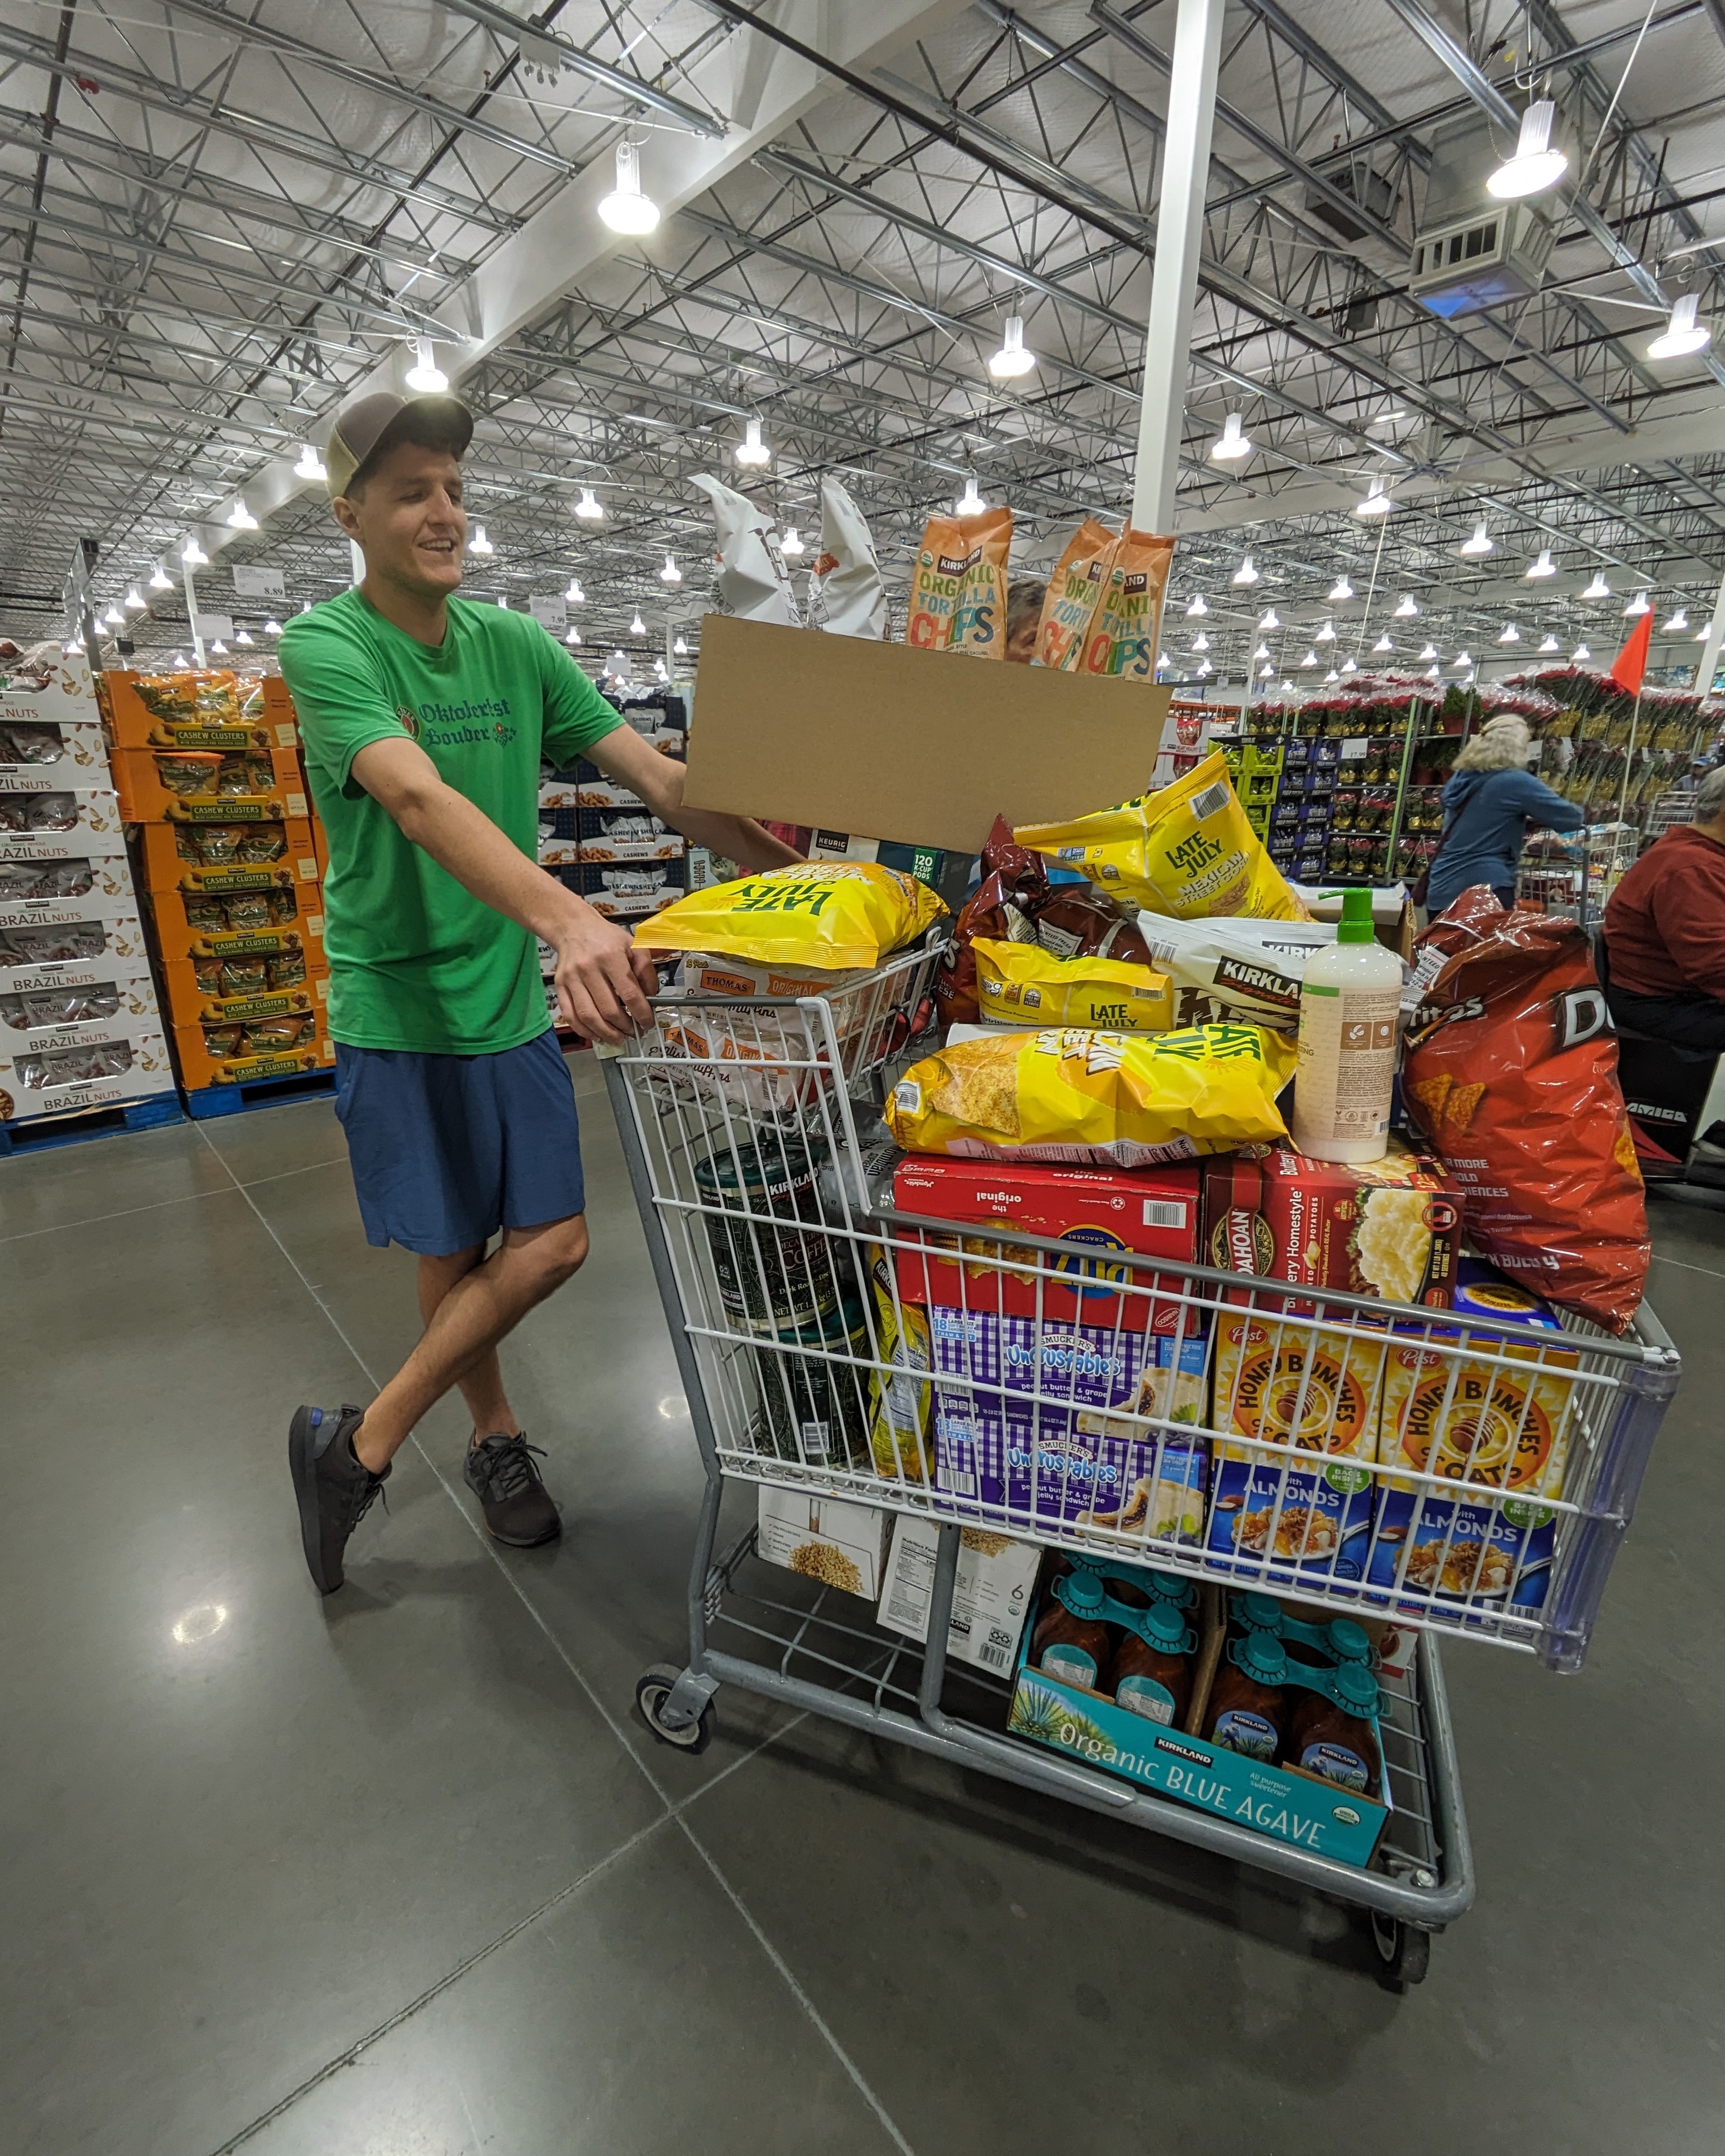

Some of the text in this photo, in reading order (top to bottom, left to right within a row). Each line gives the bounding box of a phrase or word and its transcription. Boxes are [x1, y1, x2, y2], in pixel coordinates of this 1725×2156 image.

[919, 565, 996, 597] ORGANIC
[264, 587, 283, 596] 8.89
[910, 605, 994, 650] CHIPS
[5, 708, 39, 718] NUTS
[178, 731, 245, 740] CASHEW CLUSTERS
[20, 781, 52, 790] NUTS
[194, 806, 224, 814] CASHEW
[818, 837, 847, 848] KEURIG
[1164, 830, 1208, 870] LATE
[37, 848, 68, 857] NUTS
[1184, 838, 1224, 878] JULY
[914, 854, 933, 867] 120
[913, 870, 930, 880] PODS
[914, 865, 932, 873] K-CUP
[1179, 849, 1245, 897] MEXICAN
[206, 874, 269, 885] CASHEW CLUSTERS
[727, 880, 837, 898] JULY
[1175, 882, 1221, 907] STREET
[731, 891, 835, 916] LATE
[0, 912, 82, 926] BRAZIL NUTS
[215, 938, 277, 950] CASHEW CLUSTERS
[1059, 937, 1072, 949] FRESH
[686, 959, 693, 968] 18
[13, 974, 96, 991] BRAZIL NUTS
[226, 998, 286, 1013] CASHEW CLUSTERS
[1090, 1003, 1128, 1021] LATE
[29, 1033, 109, 1051] BRAZIL NUTS
[236, 1061, 295, 1076] CASHEW CLUSTERS
[44, 1090, 122, 1110] BRAZIL NUTS
[1625, 1102, 1687, 1123] AMIGO
[1280, 1152, 1298, 1176] Buttery
[1454, 1159, 1489, 1169] MORE
[1052, 1173, 1114, 1181] original
[976, 1192, 1022, 1204] original
[992, 1204, 1007, 1213] the
[1286, 1190, 1305, 1257] Homestyle
[1309, 1196, 1319, 1239] POTATOES
[1068, 1234, 1104, 1242] CRACKERS
[933, 1319, 947, 1330] 18
[1157, 1309, 1179, 1325] NABISCO
[1085, 1389, 1108, 1398] grape
[1287, 1477, 1302, 1485] ith
[1011, 1584, 1024, 1600] 6
[1233, 1714, 1269, 1731] KIRKLAND
[1157, 1738, 1212, 1764] KIRKLAND
[1320, 1746, 1358, 1765] KIRKLAND
[1060, 1722, 1326, 1849] Organic BLUE AGAVE
[1249, 1772, 1292, 1792] All purpose
[1250, 1781, 1287, 1798] sweetener
